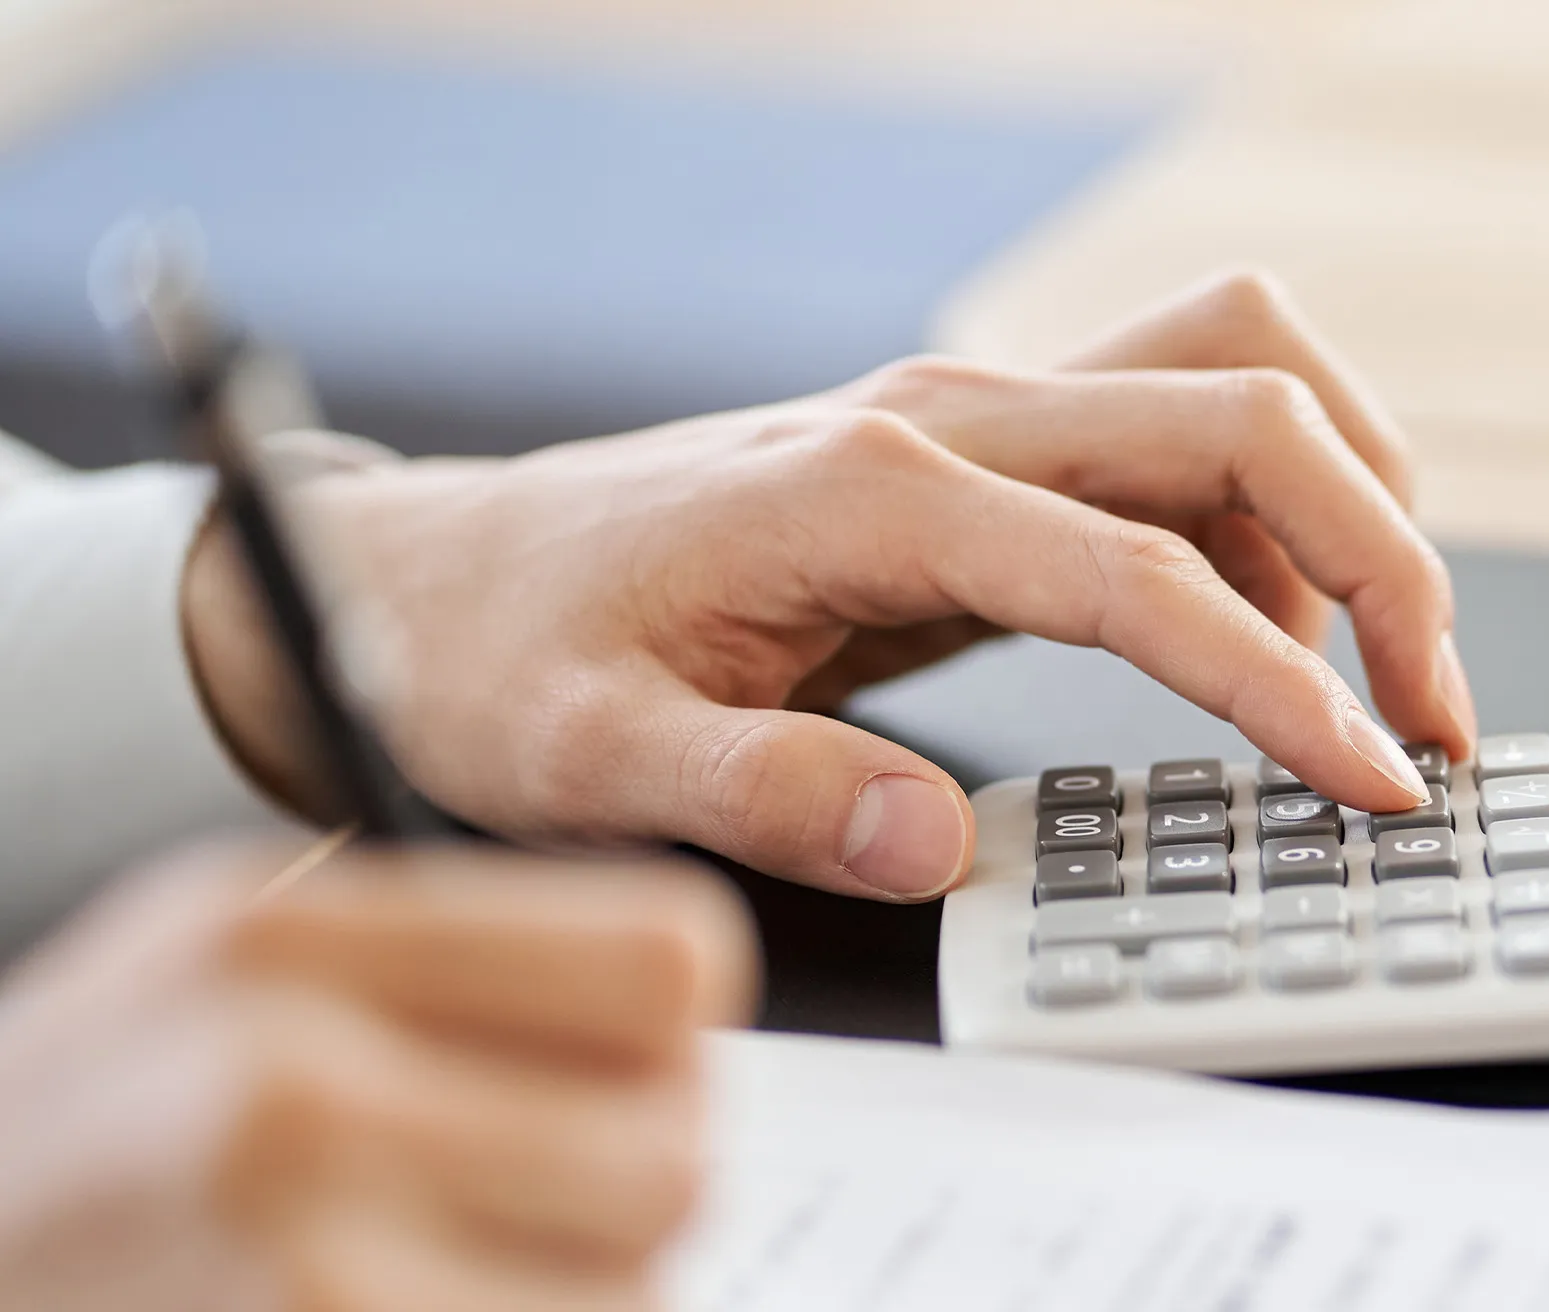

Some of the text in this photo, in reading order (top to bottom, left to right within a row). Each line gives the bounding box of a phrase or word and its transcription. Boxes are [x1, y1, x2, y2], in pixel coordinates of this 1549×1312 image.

[1164, 769, 1212, 782] 1
[1054, 776, 1100, 791] 0
[1277, 804, 1321, 819] 5
[1055, 813, 1101, 838] 00
[1163, 812, 1209, 827] 2
[1394, 839, 1441, 853] 9
[1164, 855, 1210, 869] 3
[1277, 847, 1326, 862] 6
